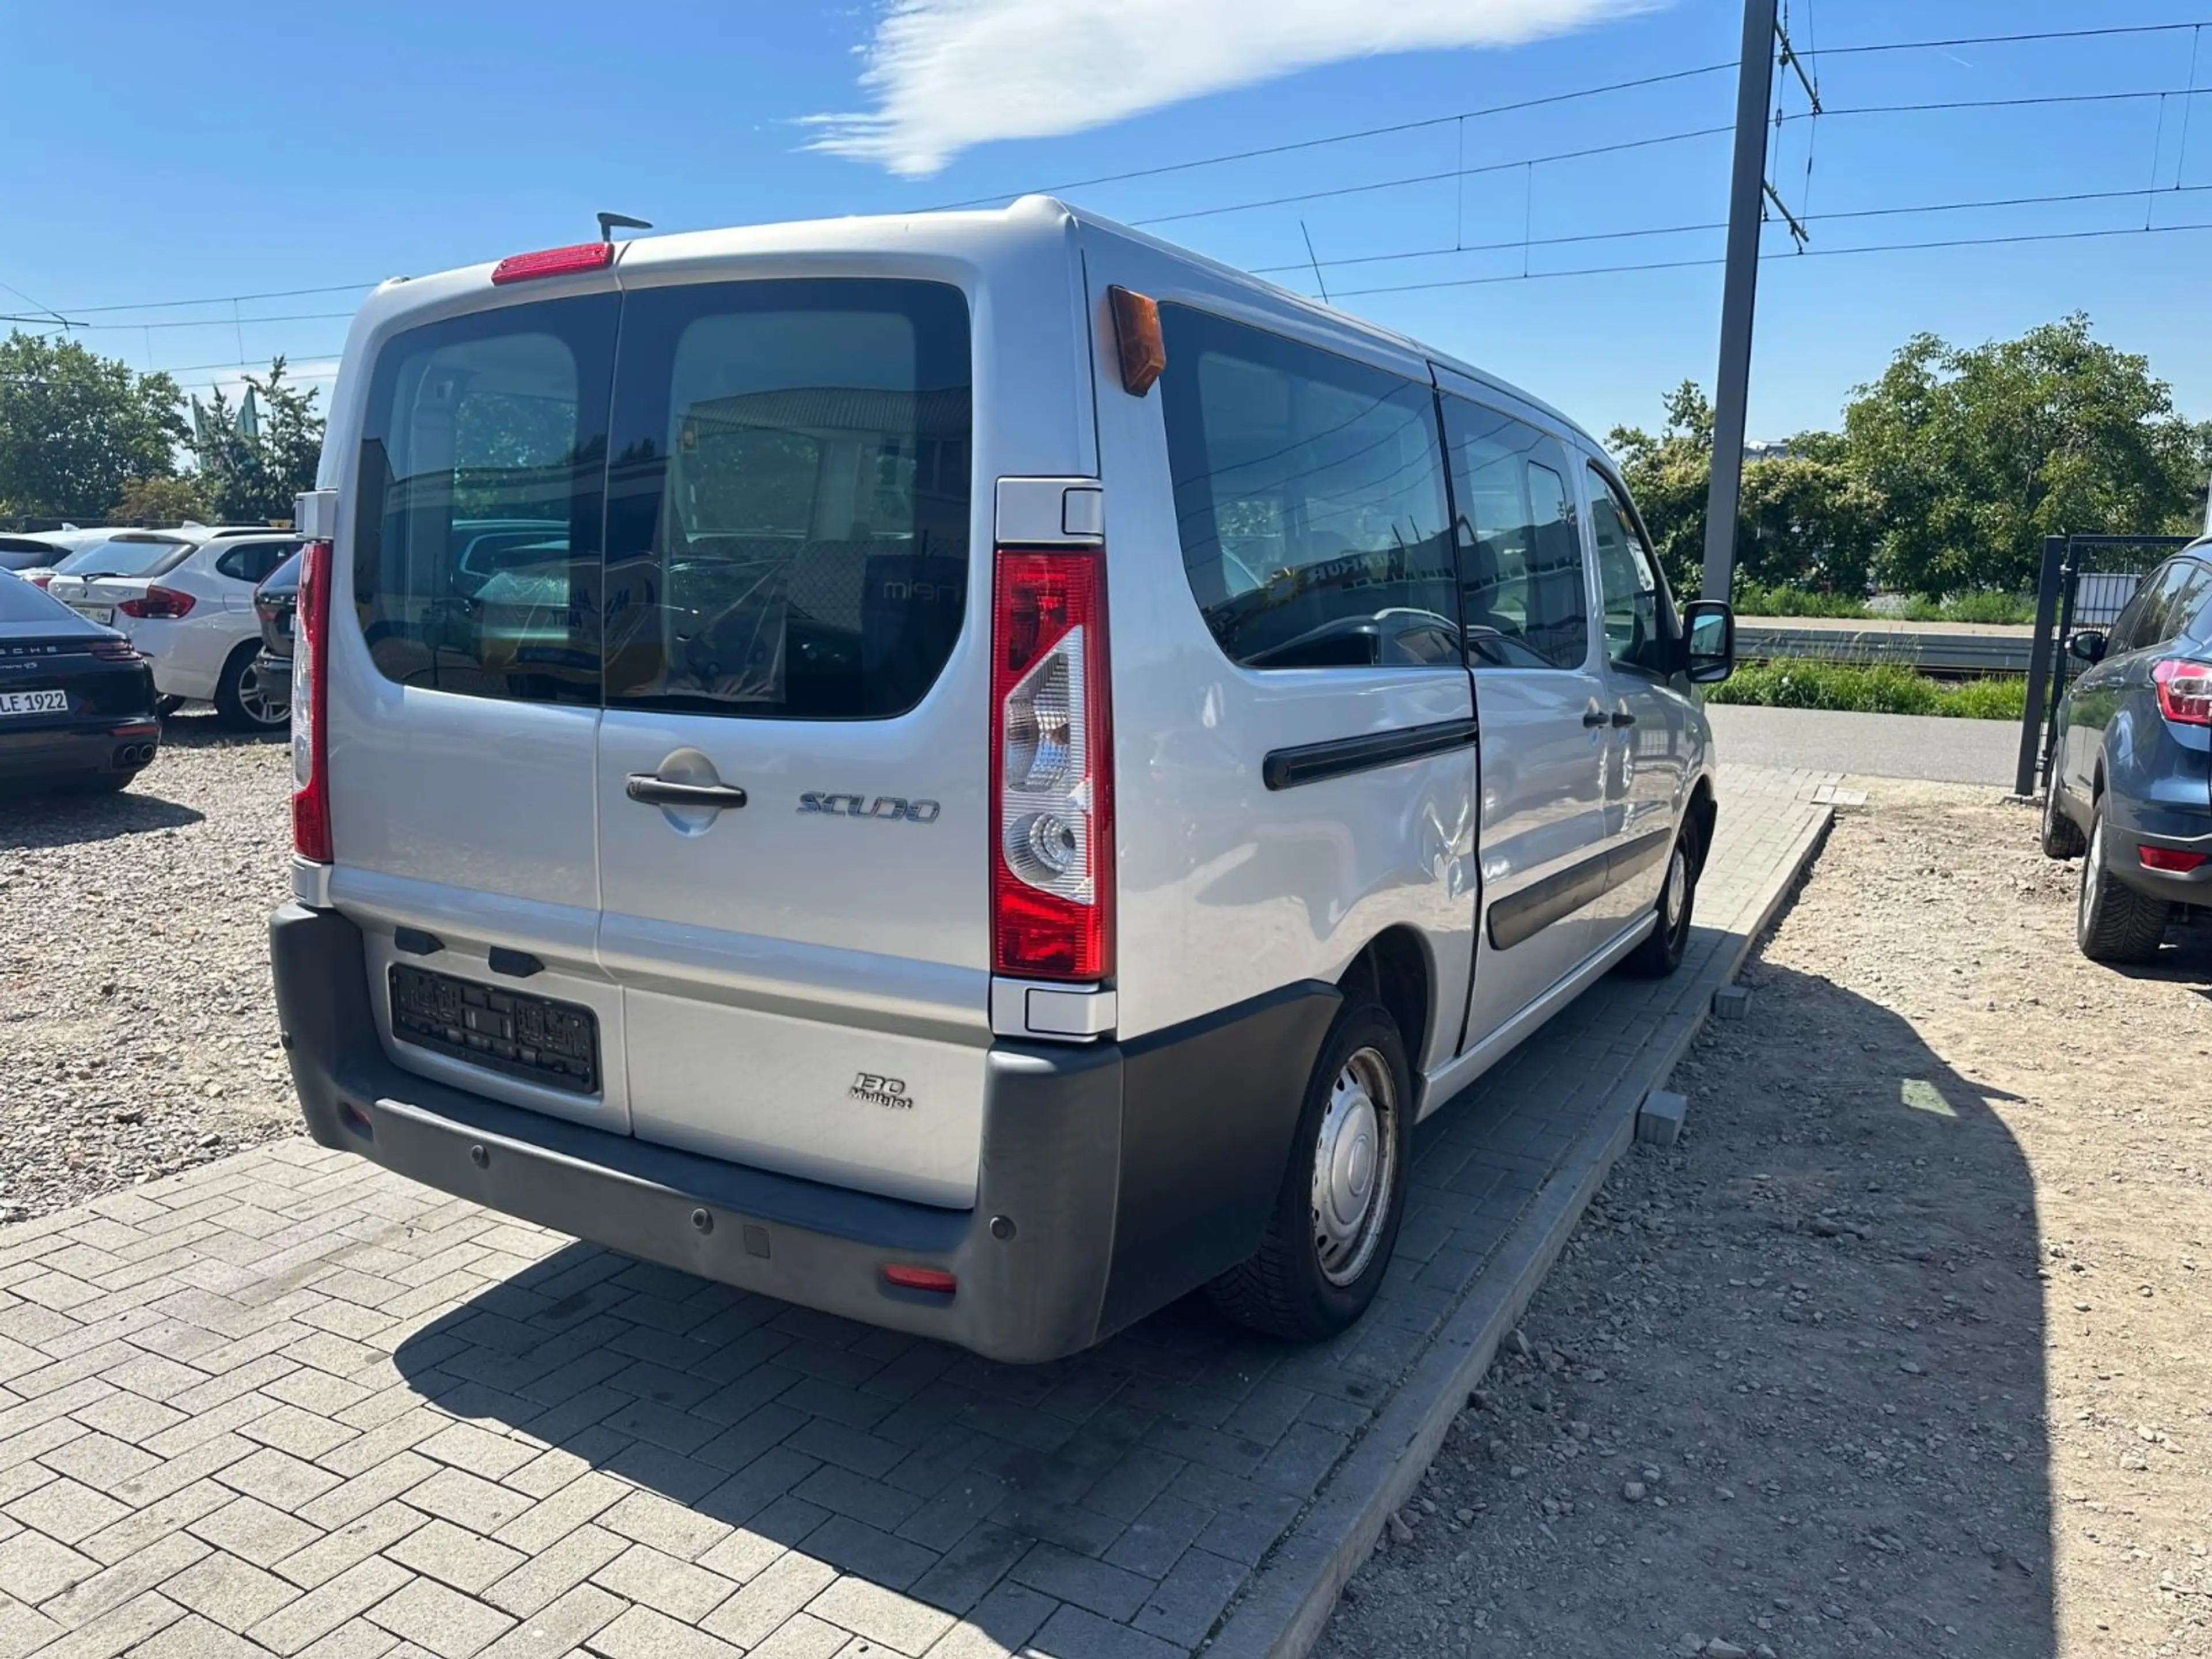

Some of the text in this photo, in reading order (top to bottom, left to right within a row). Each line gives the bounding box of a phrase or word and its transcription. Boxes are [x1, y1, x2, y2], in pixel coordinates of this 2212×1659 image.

[24, 692, 66, 711] 1922
[796, 790, 941, 824] SCUDO
[855, 1073, 906, 1096] 130
[849, 1086, 913, 1109] Multijet
